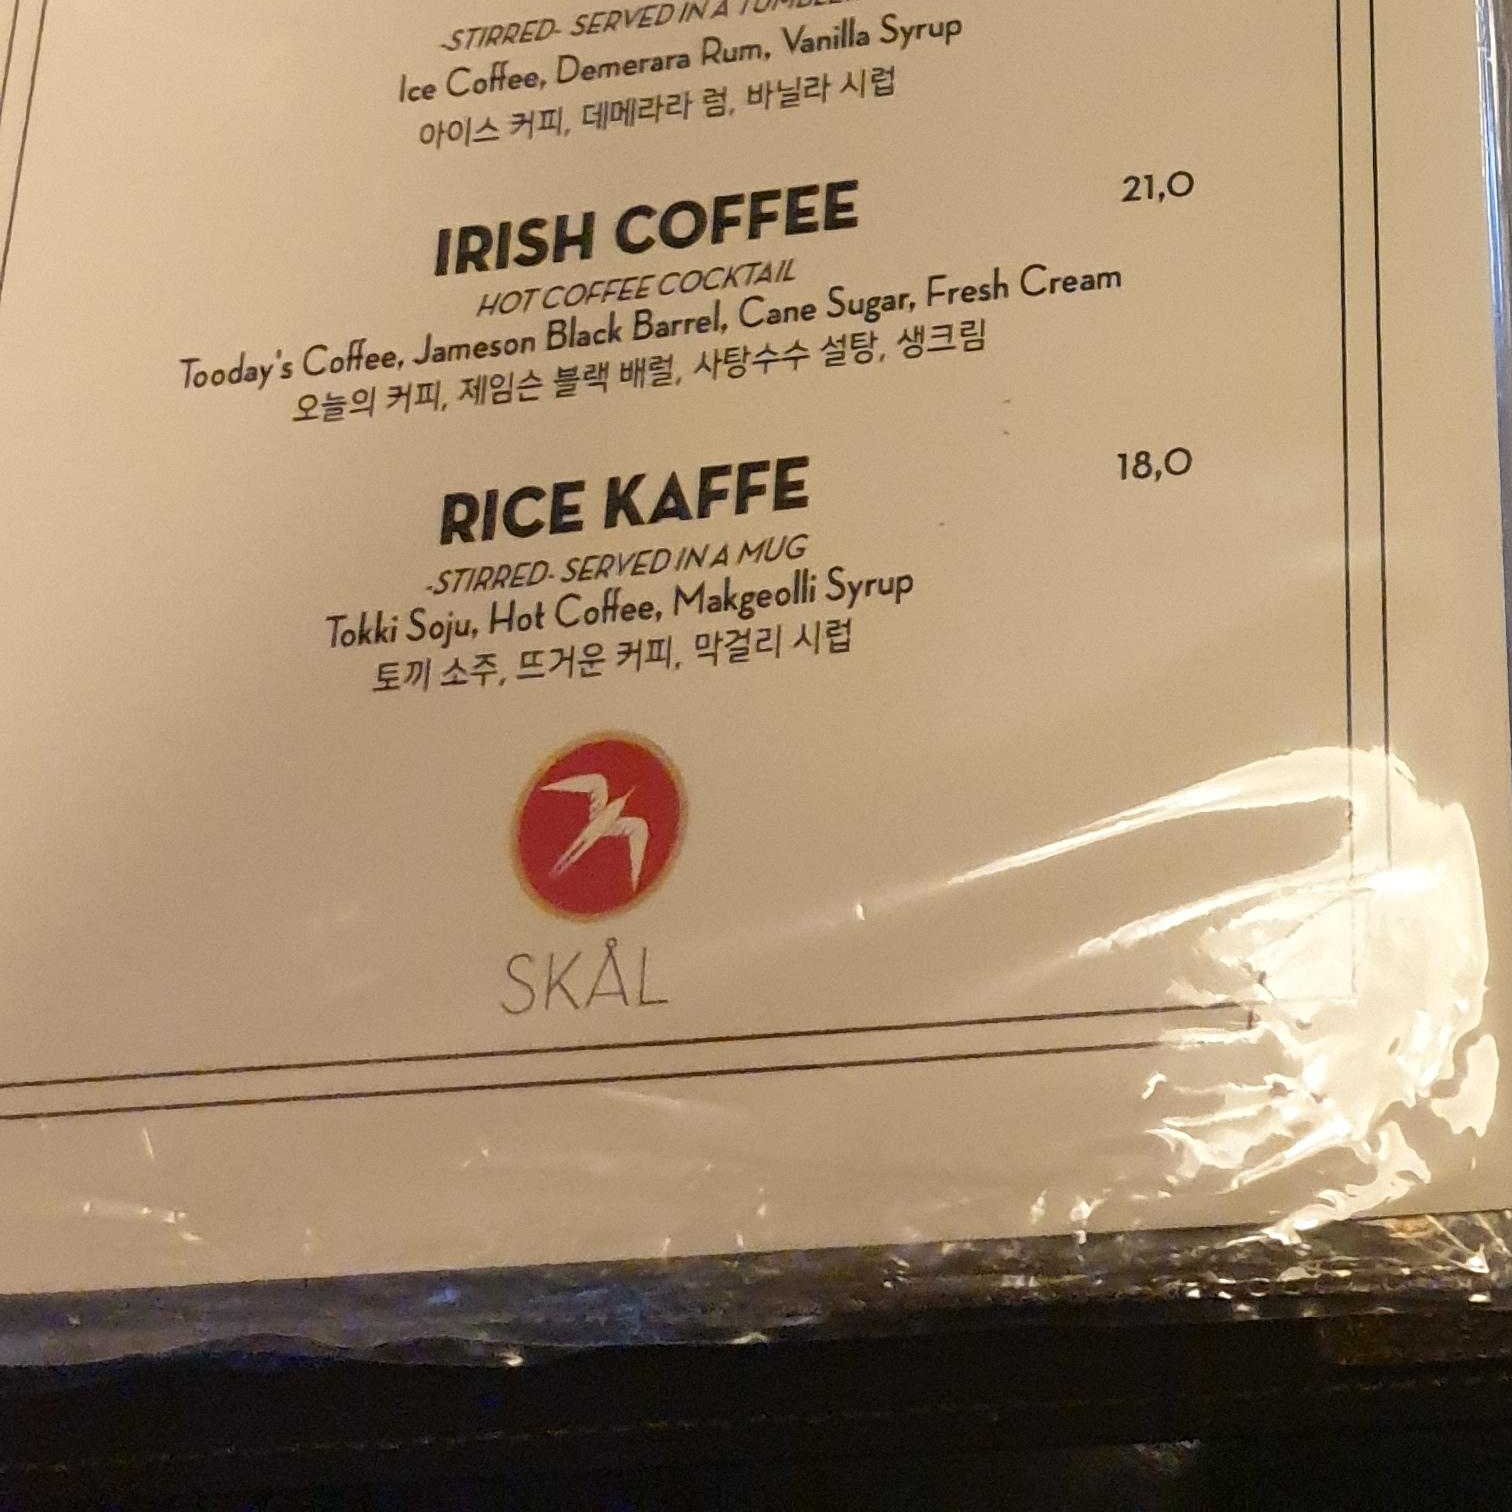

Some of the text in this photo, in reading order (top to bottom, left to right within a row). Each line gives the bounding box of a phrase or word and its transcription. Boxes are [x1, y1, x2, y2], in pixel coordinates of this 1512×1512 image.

[399, 13, 962, 102] Ice Coffee, Demerara Rum, Vanilla Syrup
[434, 179, 859, 277] IRISH COFFEE
[180, 263, 1121, 390] Tooday's Coffee, Jameson Black Barrel, Cane Sugar, Fresh Cream
[476, 259, 795, 317] HOT COFFEE COCKTAIL
[439, 455, 810, 546] RICE KAFFE
[326, 566, 914, 649] Tokki Soju, Hot Coffee, Makgeolli Syrup
[372, 658, 431, 692] 토끼
[516, 643, 606, 680] 뜨거운
[695, 625, 781, 666] 막걸리
[793, 618, 851, 655] 시럽
[502, 937, 668, 1015] SKÅL
